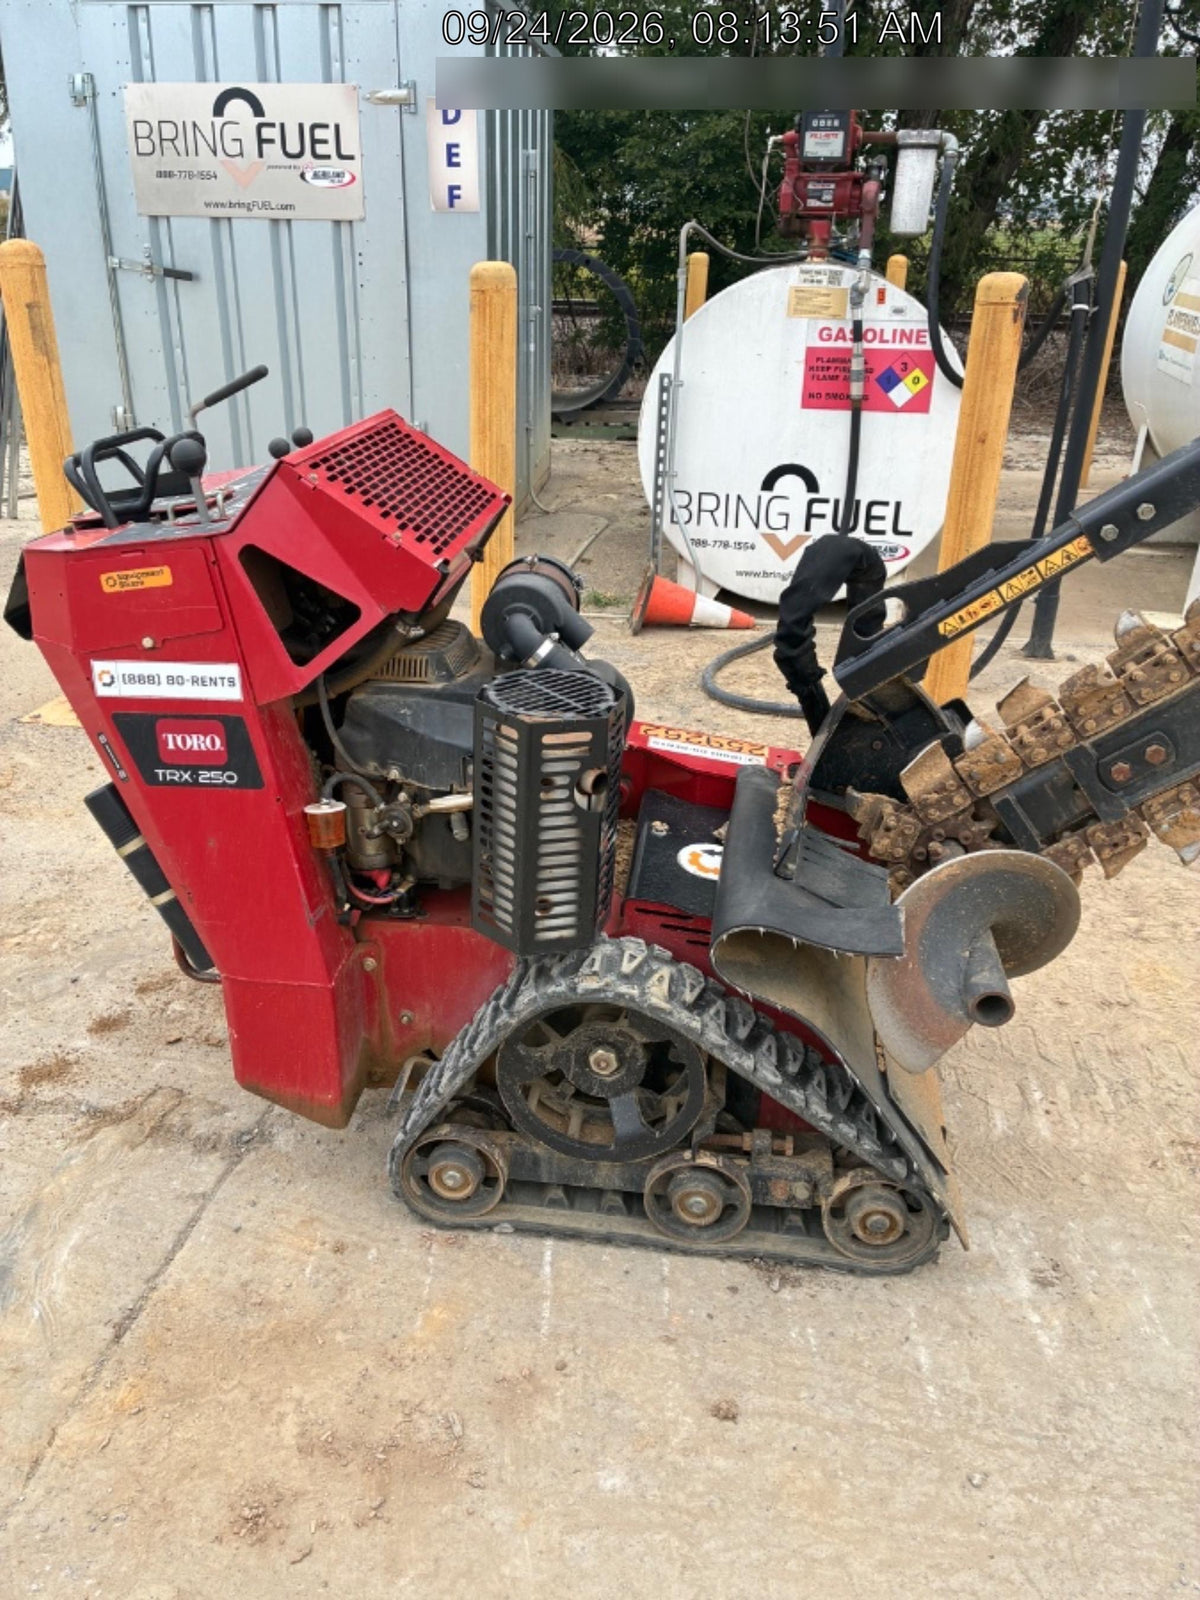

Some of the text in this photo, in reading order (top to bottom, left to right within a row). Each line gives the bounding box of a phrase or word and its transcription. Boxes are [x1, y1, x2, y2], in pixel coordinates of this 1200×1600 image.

[133, 120, 356, 161] BRING FUEL
[204, 200, 296, 212] www.bringFUEL.com
[901, 362, 908, 372] 3
[911, 376, 920, 385] 0
[808, 392, 869, 401] NO SMOKG
[670, 489, 913, 537] BRING FUEL
[735, 569, 794, 582] www.bring
[166, 674, 236, 688] 80-RENTS
[162, 732, 222, 751] TORO
